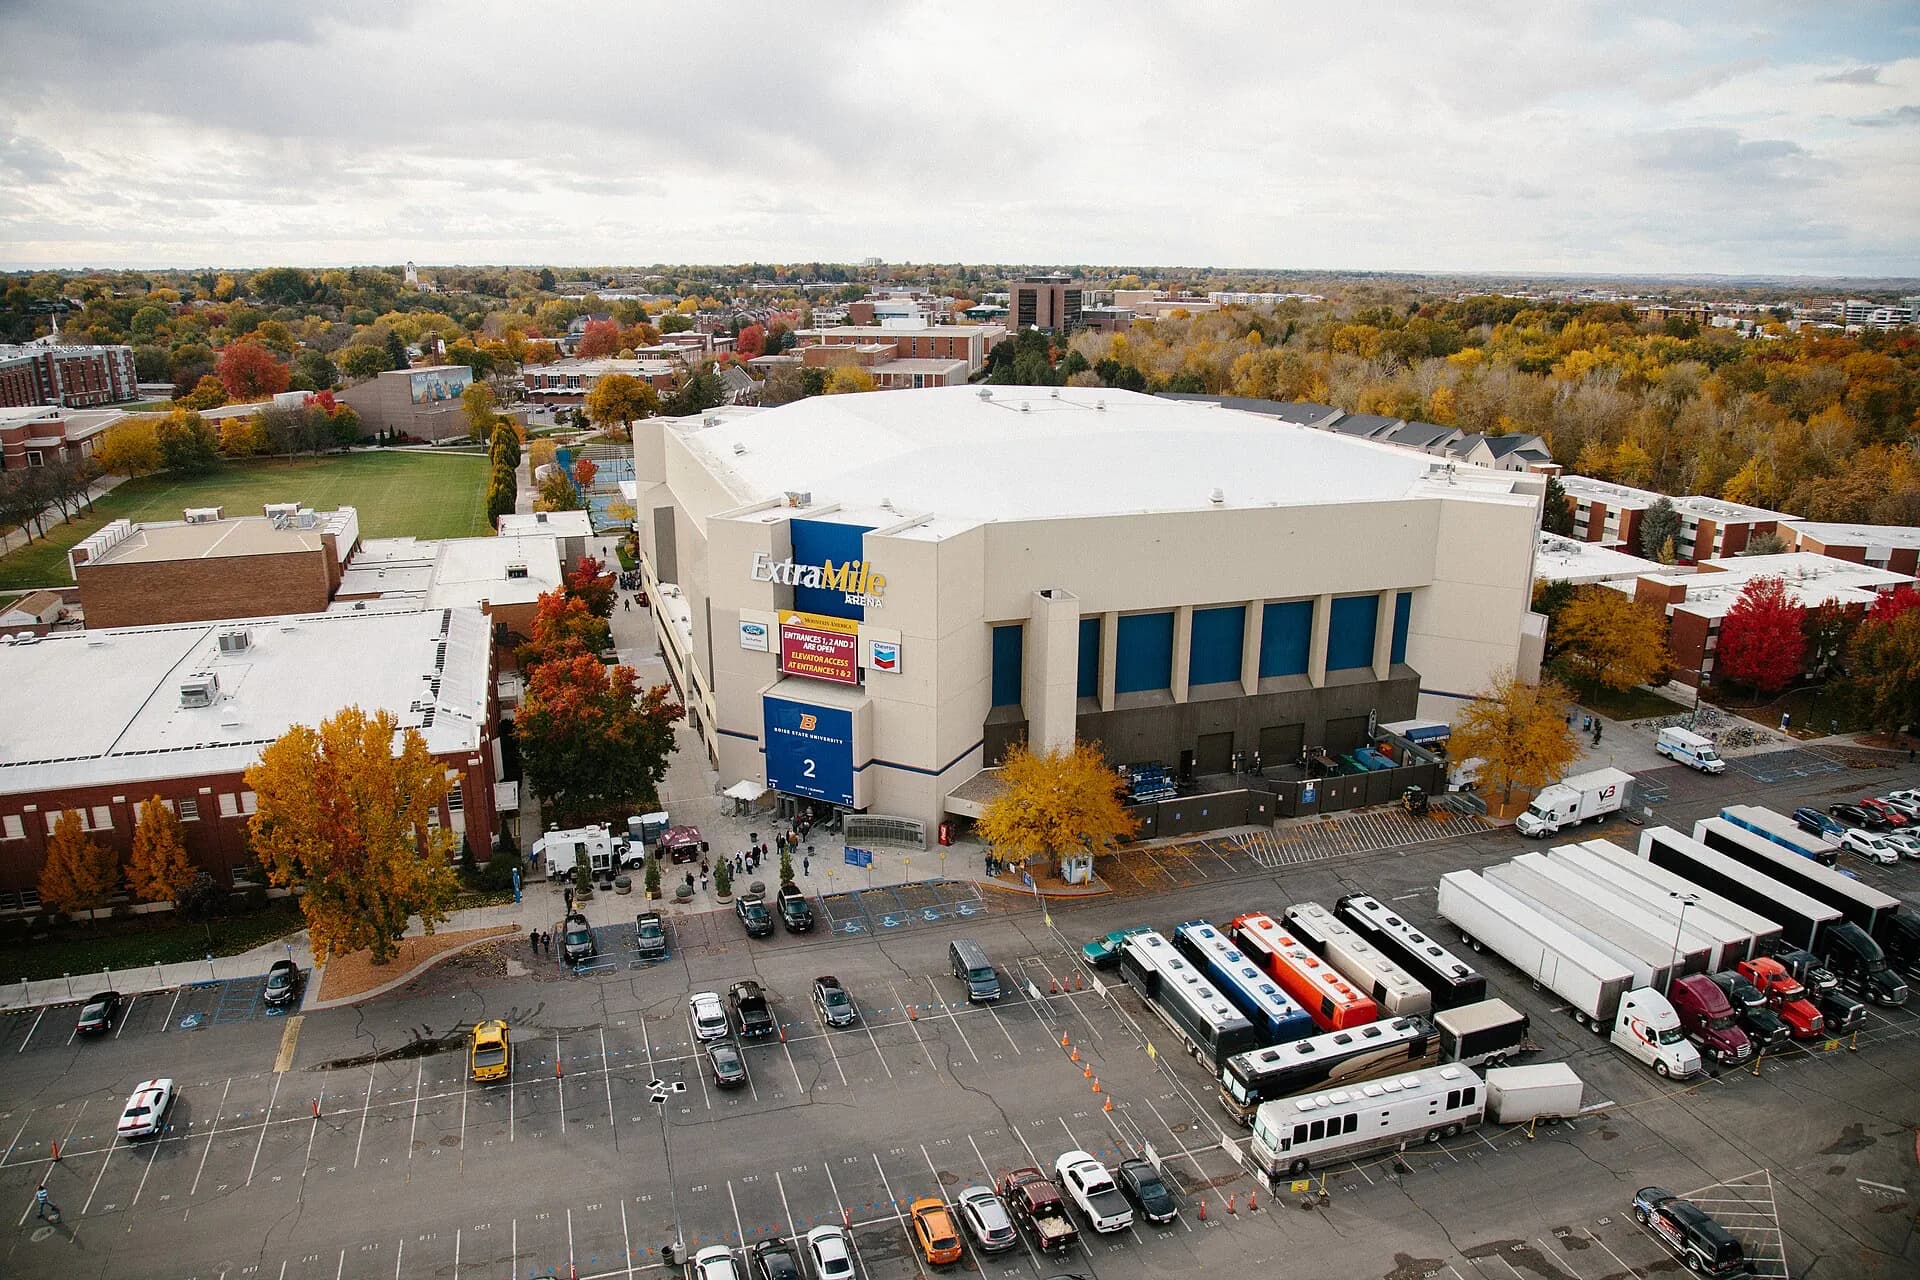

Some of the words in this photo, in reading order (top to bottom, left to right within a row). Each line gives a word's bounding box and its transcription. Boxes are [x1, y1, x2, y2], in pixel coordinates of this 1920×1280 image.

[845, 594, 883, 608] ARENA
[784, 632, 822, 643] ENTRANCES
[834, 639, 848, 648] AND
[817, 645, 835, 654] OPEN
[792, 652, 824, 663] ELEVATOR
[824, 658, 848, 666] ACCESS
[797, 663, 834, 675] ENTRANCES
[800, 714, 817, 731] B
[810, 734, 843, 744] UNIVERSITY
[803, 759, 816, 778] 2
